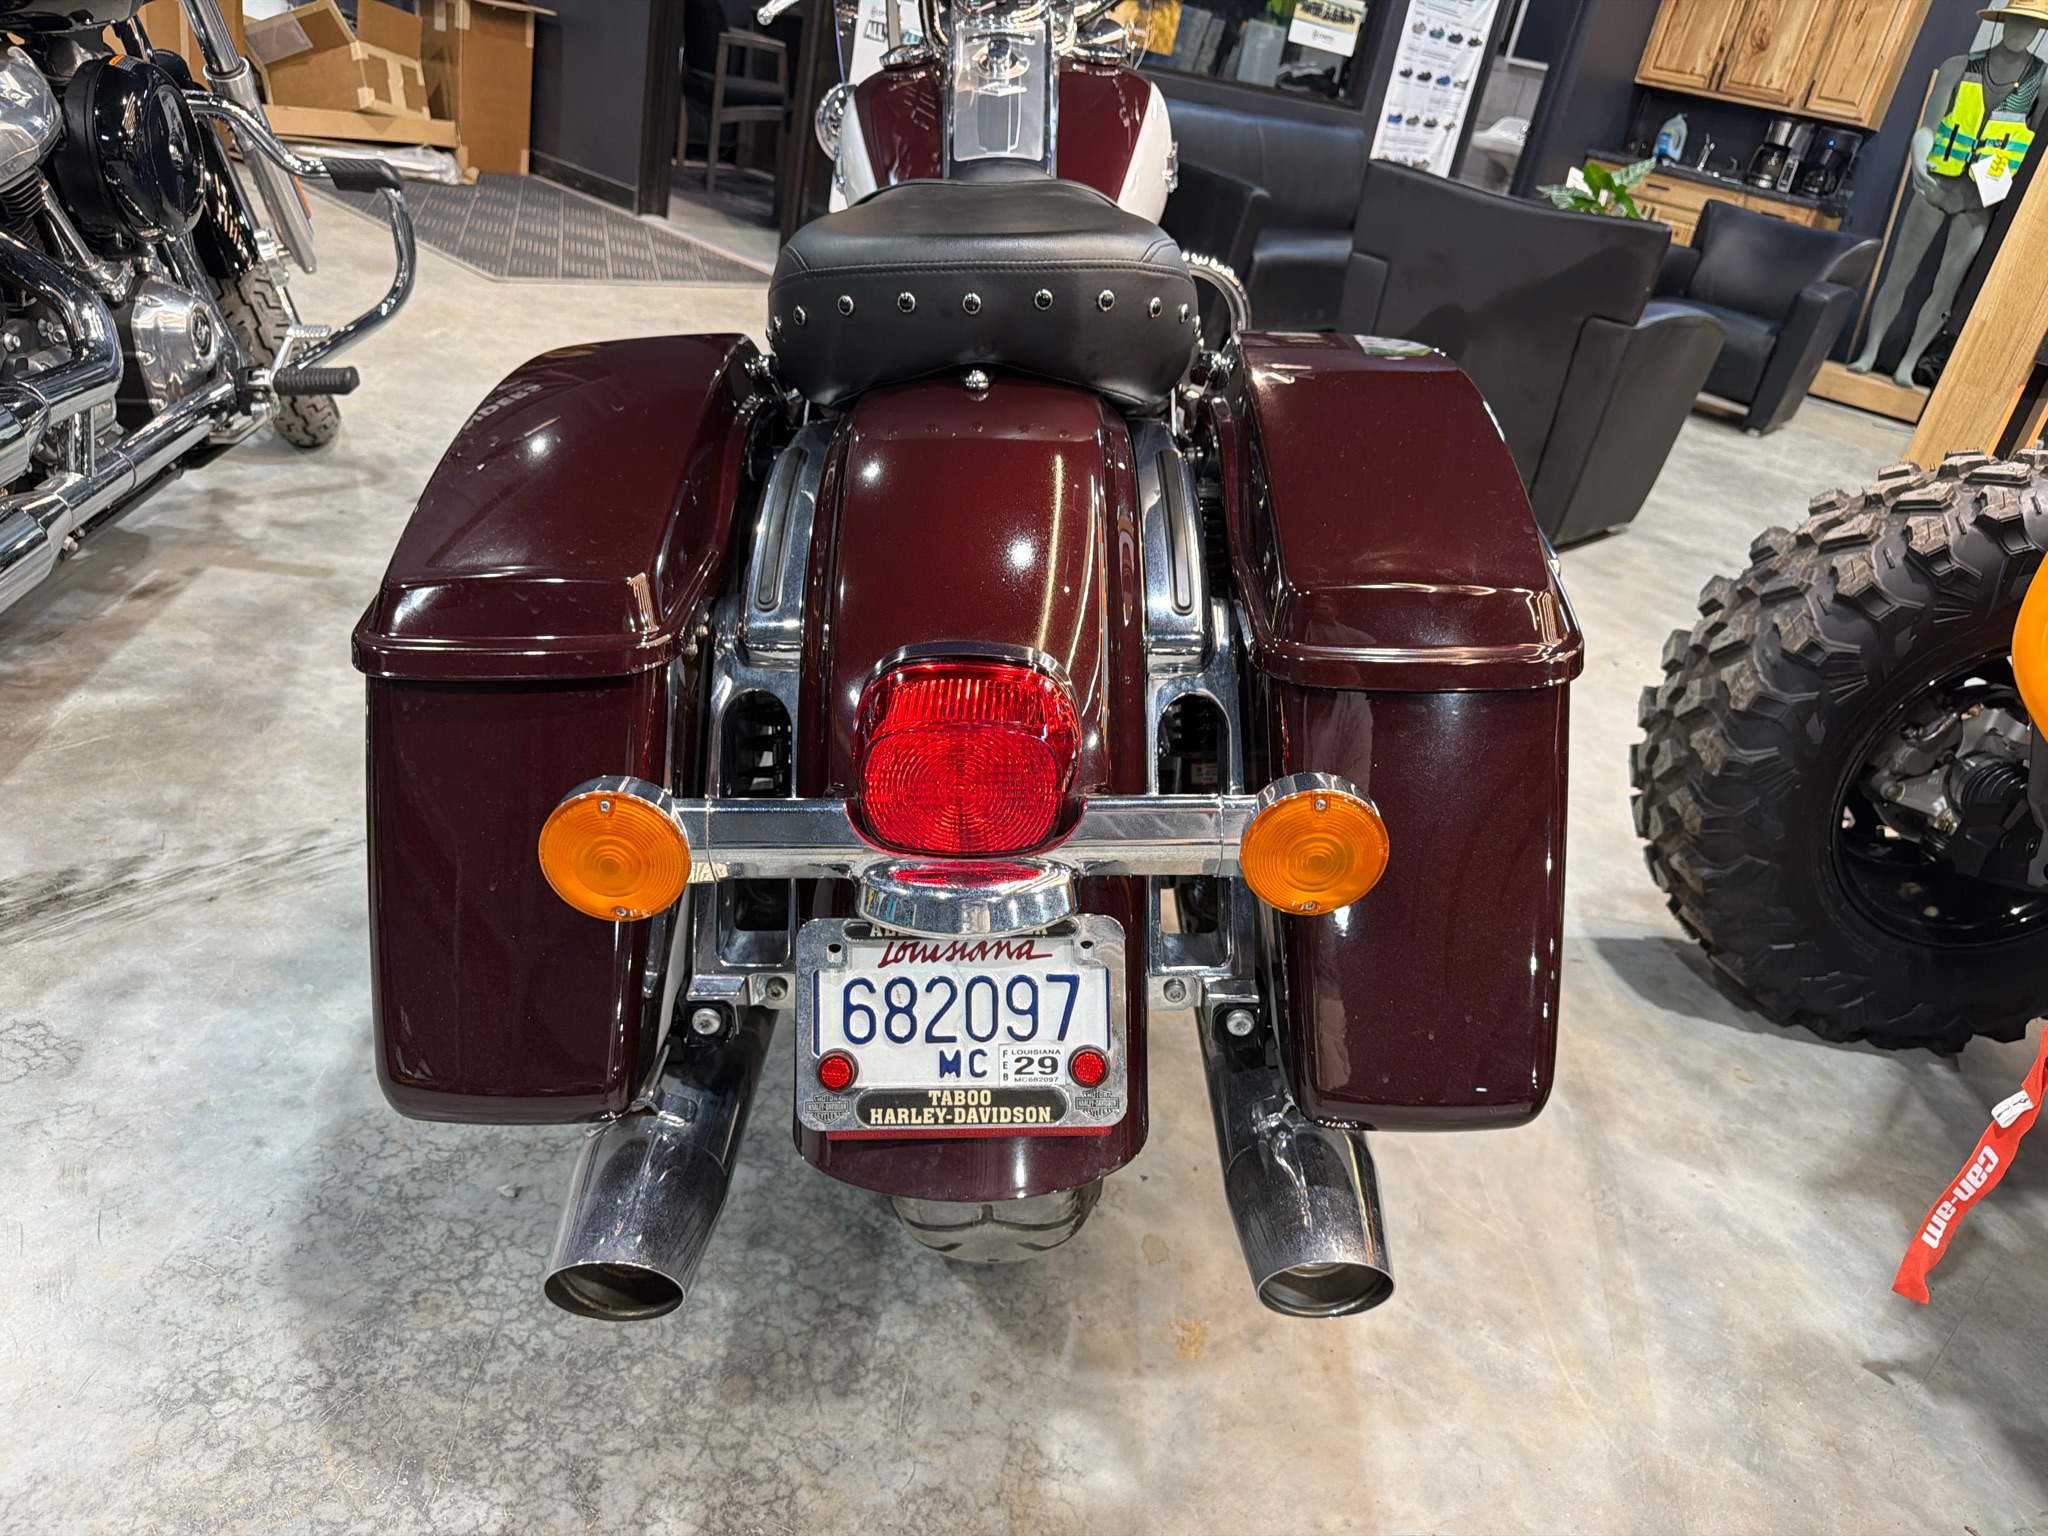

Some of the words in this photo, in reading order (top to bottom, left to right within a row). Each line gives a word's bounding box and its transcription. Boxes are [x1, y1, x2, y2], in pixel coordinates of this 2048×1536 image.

[878, 940, 1053, 968] Louisiana
[843, 974, 1080, 1044] 682097
[940, 1049, 988, 1078] MC
[1014, 1056, 1059, 1076] 29
[928, 1090, 992, 1106] TABOO
[870, 1106, 1052, 1125] HARLEY-DAVIDSON
